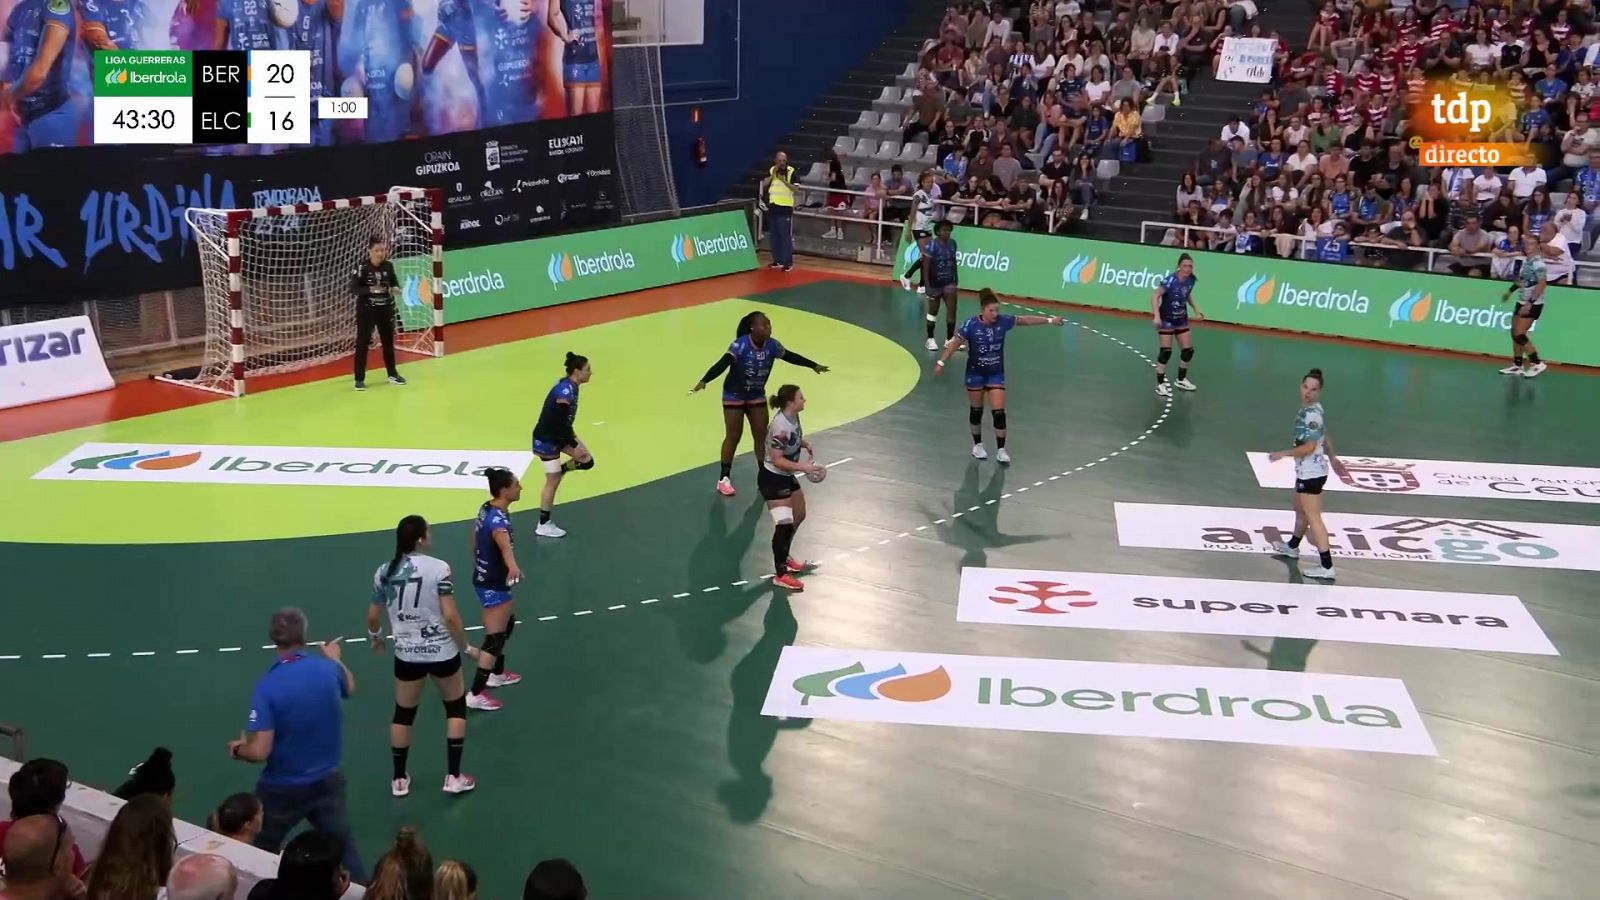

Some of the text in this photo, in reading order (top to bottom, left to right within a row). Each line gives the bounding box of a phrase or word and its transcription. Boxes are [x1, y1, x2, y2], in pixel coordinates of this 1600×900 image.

[415, 162, 460, 176] GIPUZKOA
[694, 231, 748, 257] Iberdrola
[573, 248, 635, 278] Iberdrola
[955, 247, 1010, 271] erdrola
[441, 268, 505, 298] berdrola
[1098, 262, 1170, 290] Iberdro
[1277, 282, 1370, 314] Iberdrola
[1434, 299, 1537, 332] Iberdro
[208, 456, 511, 476] Iberdrola
[1432, 472, 1519, 482] Ciudad
[1437, 479, 1471, 487] de
[1203, 543, 1255, 551] RUGS
[1374, 552, 1437, 561] HOME
[390, 577, 423, 611] 77
[1132, 597, 1509, 629] super amara
[977, 676, 1403, 729] Iberdrola
